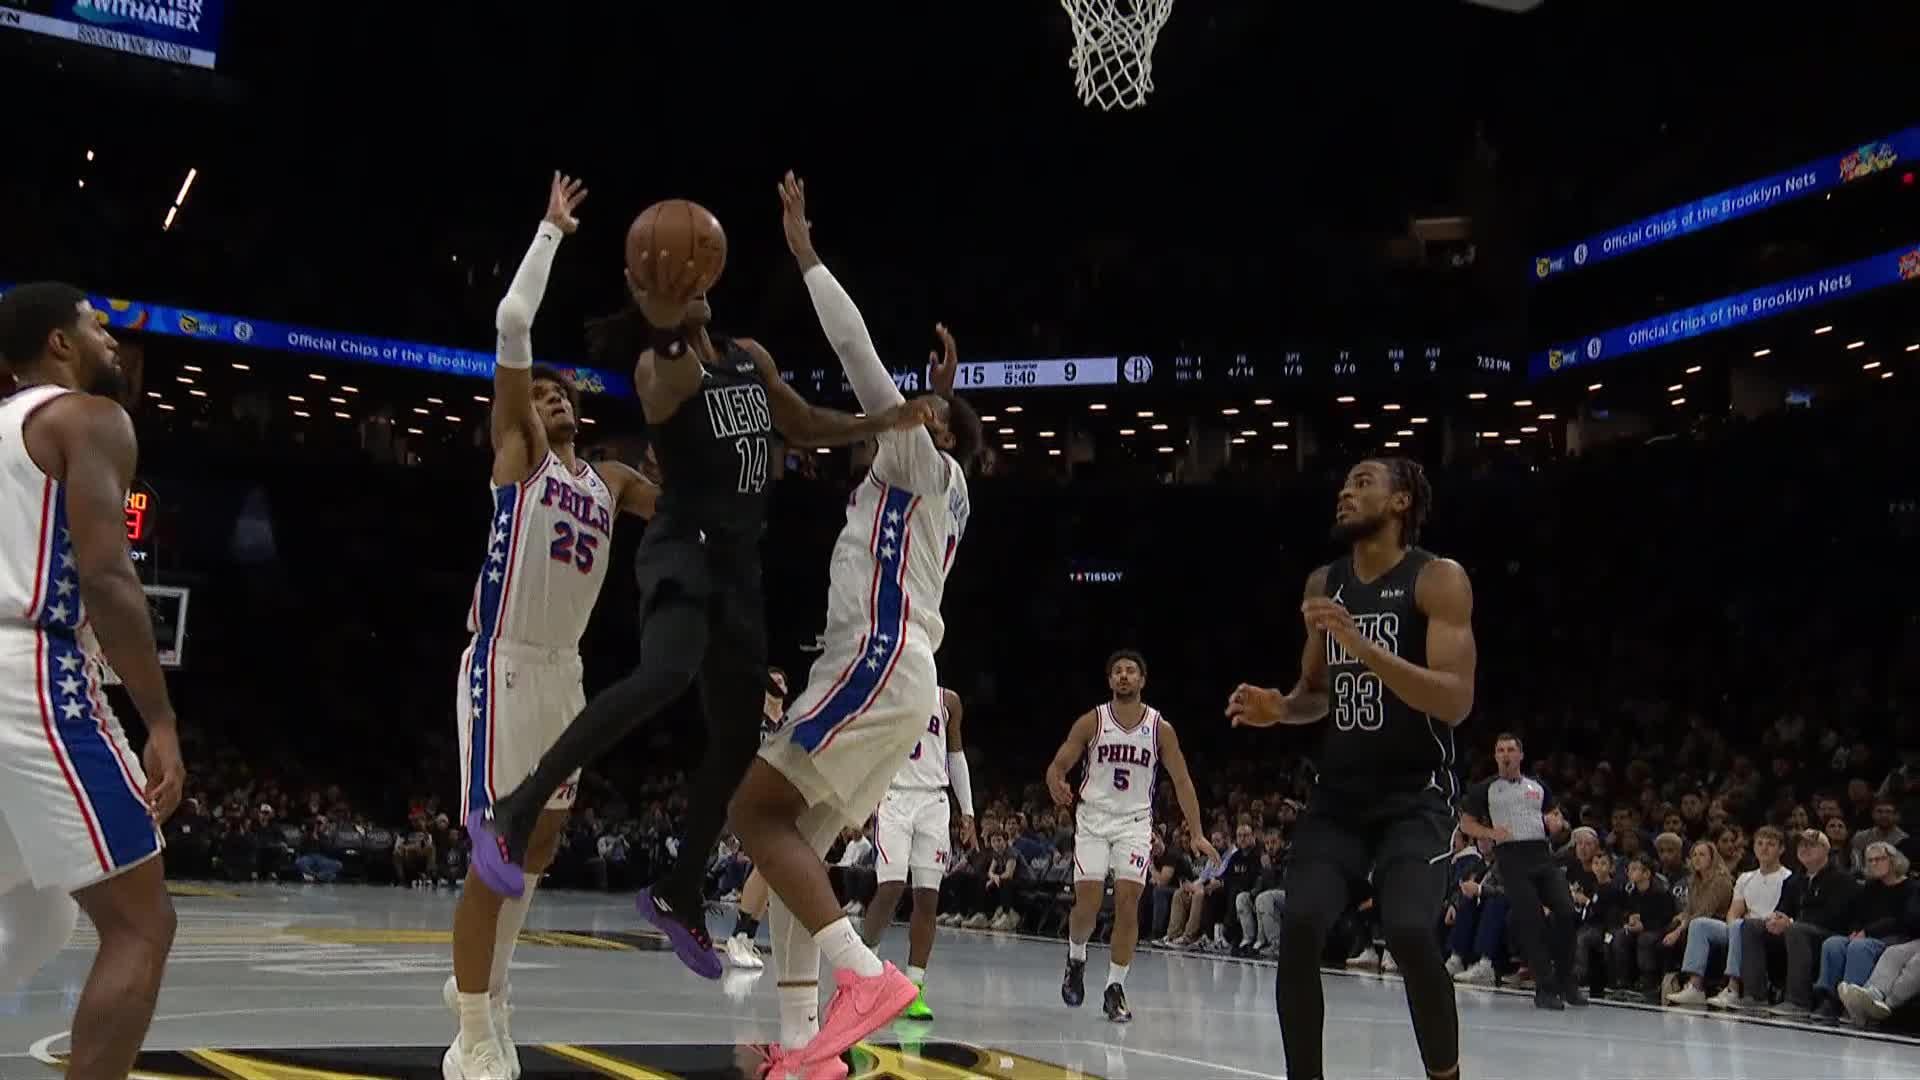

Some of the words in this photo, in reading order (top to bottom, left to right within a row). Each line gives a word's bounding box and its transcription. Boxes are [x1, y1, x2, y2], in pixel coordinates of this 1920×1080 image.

[1603, 229, 1642, 253] Official
[1645, 219, 1677, 239] Chips
[1681, 210, 1694, 226] of
[1697, 205, 1718, 221] the
[1721, 185, 1781, 213] Brooklyn
[1785, 171, 1817, 193] Nets
[1628, 325, 1668, 345] Official
[1672, 316, 1706, 333] Chips
[1710, 307, 1723, 322] of
[1728, 302, 1748, 319] the
[1752, 285, 1814, 312] Brooklyn
[1818, 273, 1852, 295] Nets
[287, 331, 337, 351] Official
[340, 340, 380, 359] Chips
[383, 346, 398, 360] of
[401, 347, 424, 364] the
[427, 351, 488, 373] Brooklyn
[961, 366, 985, 385] 15
[1004, 370, 1036, 385] 5:40
[1063, 362, 1077, 381] 9
[704, 384, 771, 439] NETS
[736, 437, 768, 493] 14
[551, 521, 598, 575] 25
[1335, 671, 1384, 732] 33
[1113, 767, 1130, 791] 5
[1130, 852, 1145, 868] 76
